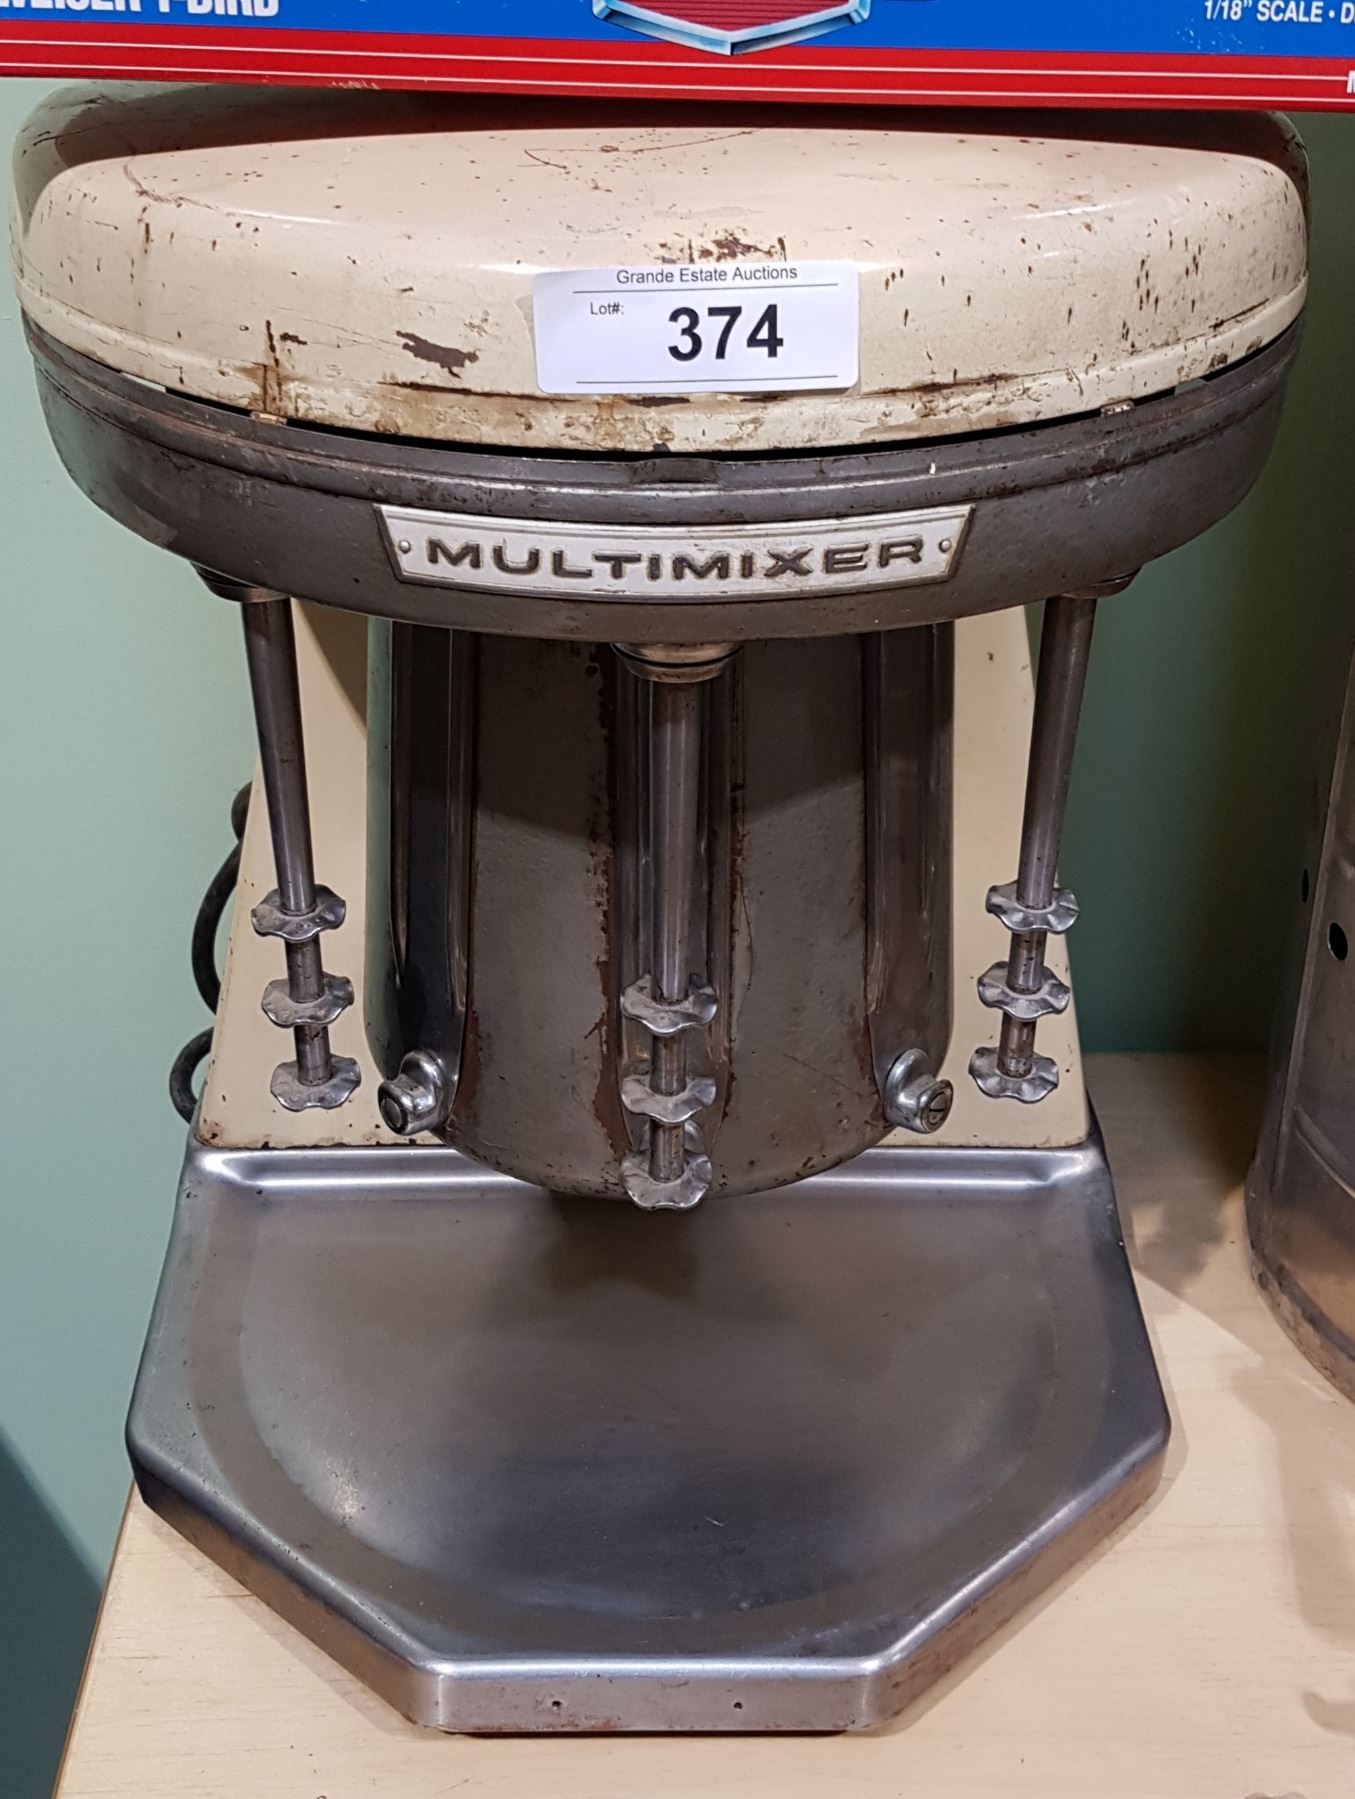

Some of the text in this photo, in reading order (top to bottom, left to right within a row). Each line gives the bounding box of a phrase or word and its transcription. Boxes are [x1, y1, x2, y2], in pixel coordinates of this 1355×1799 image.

[158, 0, 279, 17] BIRD
[1256, 0, 1324, 23] SCALE
[1340, 2, 1355, 24] D
[616, 265, 798, 285] Grande Estate Auctions
[589, 302, 624, 315] Lot#:
[667, 303, 784, 362] 374
[425, 535, 925, 582] MULTIMIXER
